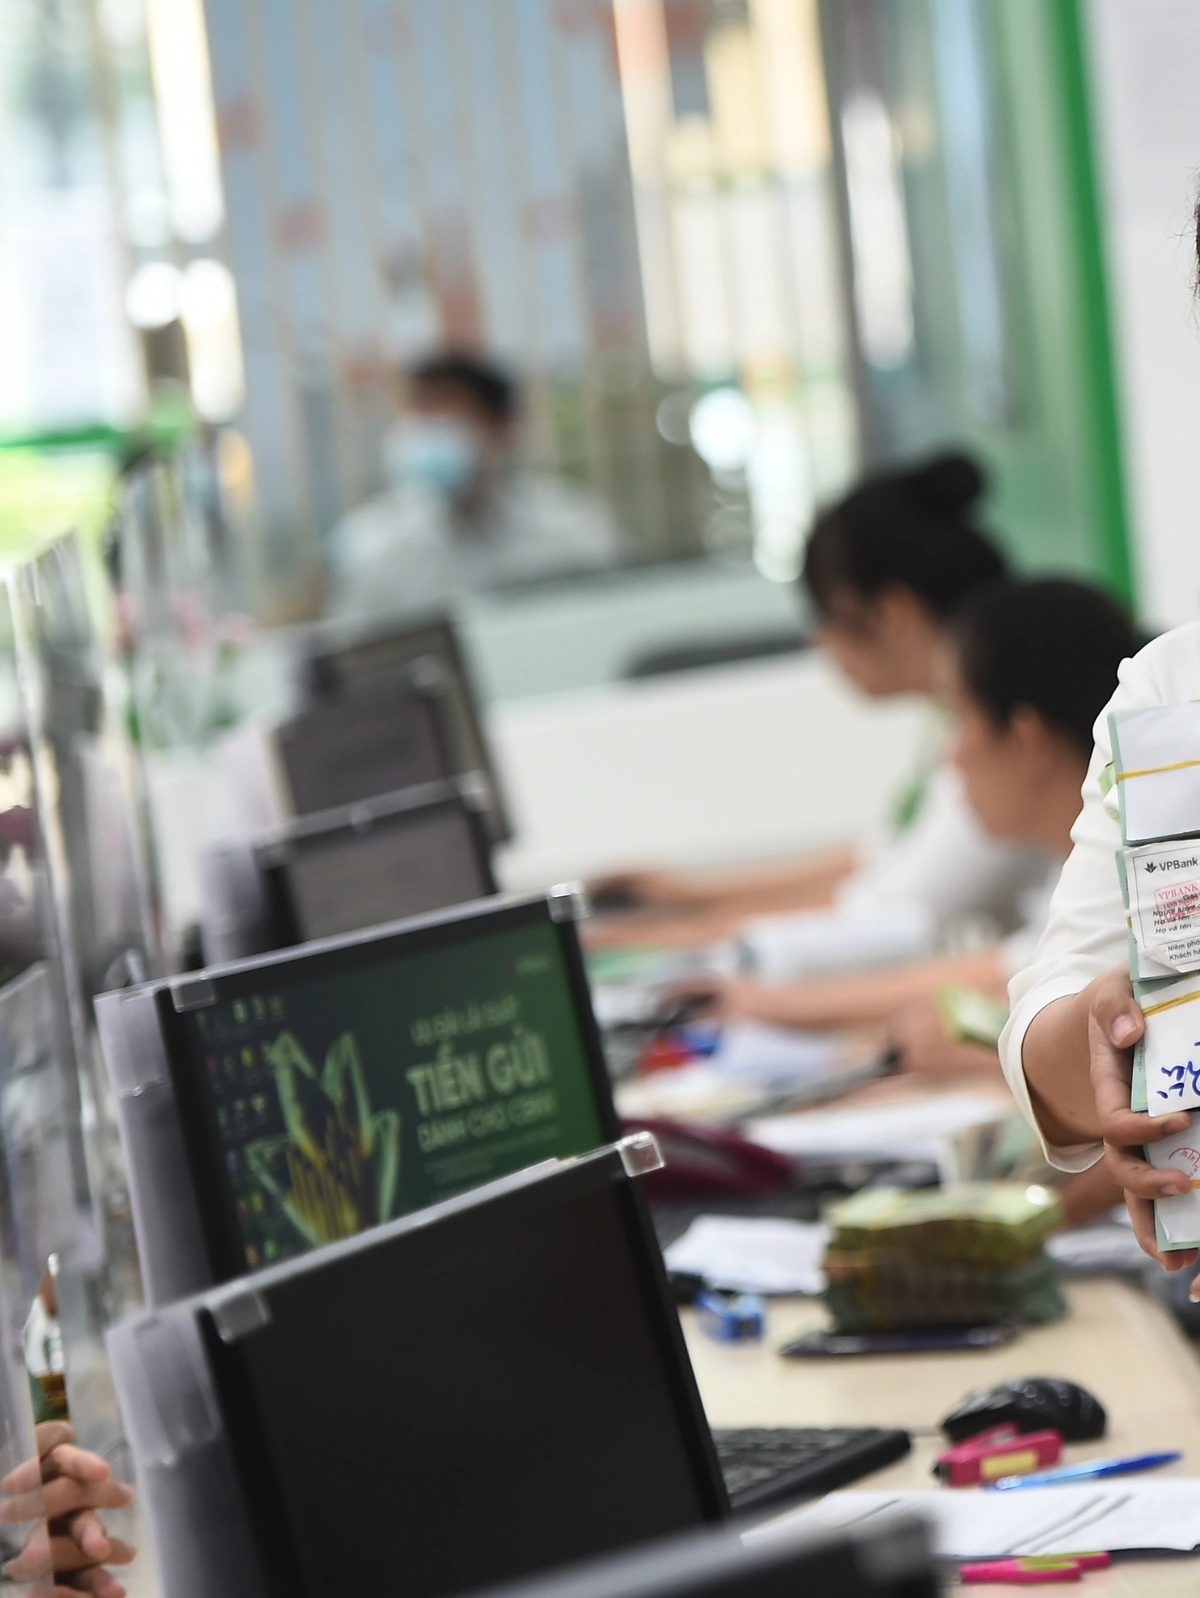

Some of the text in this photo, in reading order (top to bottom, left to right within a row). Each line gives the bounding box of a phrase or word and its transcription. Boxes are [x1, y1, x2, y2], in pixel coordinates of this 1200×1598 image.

[1159, 857, 1199, 872] VPBank
[1158, 883, 1199, 900] VPBANK
[1167, 942, 1186, 953] Niêm
[1169, 950, 1192, 962] Khách
